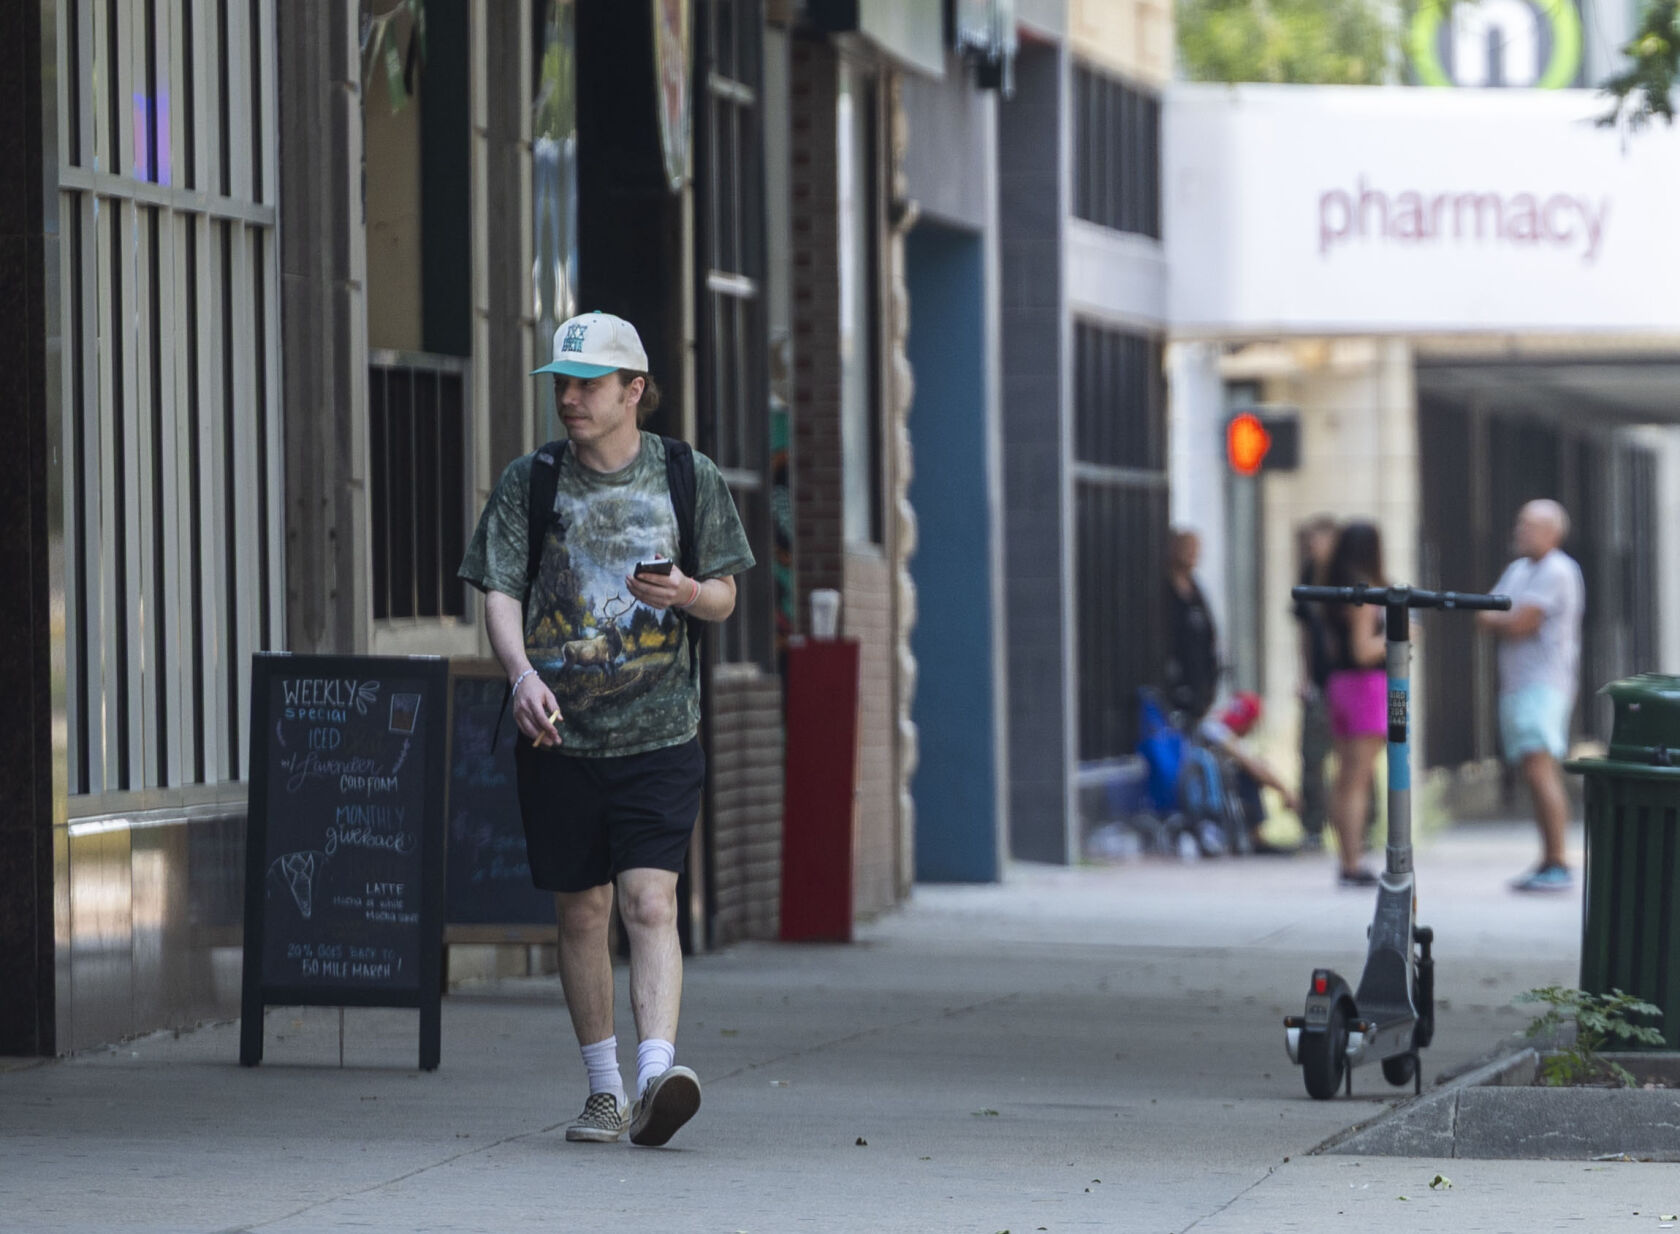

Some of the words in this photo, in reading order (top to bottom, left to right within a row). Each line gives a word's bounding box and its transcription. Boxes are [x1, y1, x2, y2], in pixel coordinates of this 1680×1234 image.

[1318, 173, 1611, 264] pharmacy
[283, 679, 357, 705] WEEKLY
[309, 728, 341, 749] ICED
[336, 804, 405, 830] MONTHLY
[366, 882, 404, 895] LATTE
[323, 961, 348, 977] MILE
